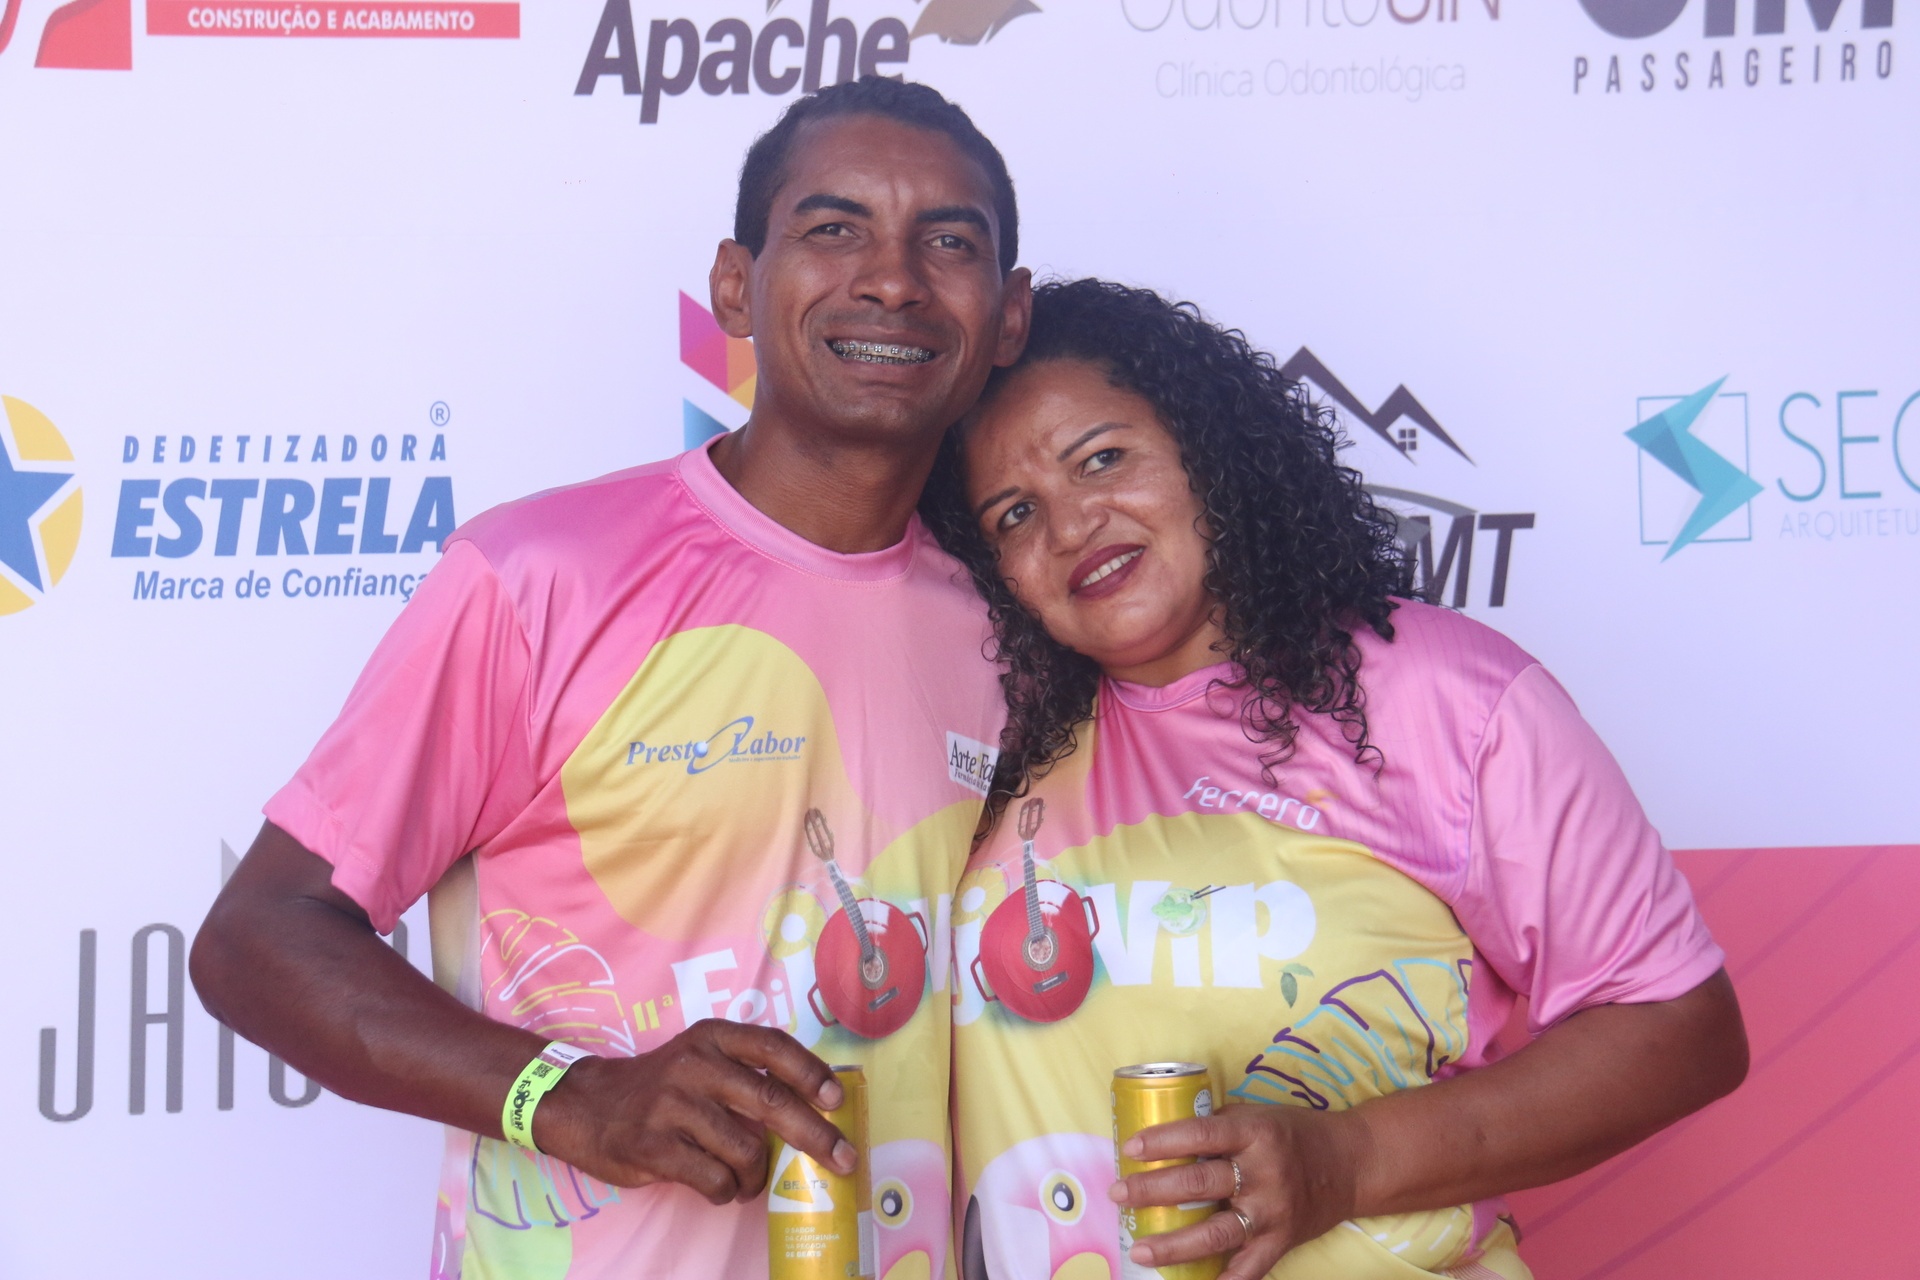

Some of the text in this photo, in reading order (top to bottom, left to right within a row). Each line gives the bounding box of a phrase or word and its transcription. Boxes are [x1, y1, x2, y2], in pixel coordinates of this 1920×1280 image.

[187, 5, 475, 33] CONSTRUÇÃO E ACABAMENTO
[573, 0, 910, 124] Apache
[1155, 56, 1466, 102] Clínica Odontológica
[1573, 40, 1893, 94] PASSAGEIRO
[123, 434, 447, 463] DEDETIZADORA
[110, 476, 457, 558] ESTRELA
[133, 571, 224, 600] Marca
[235, 569, 271, 599] de
[730, 730, 806, 757] Labor
[949, 740, 976, 774] Arte
